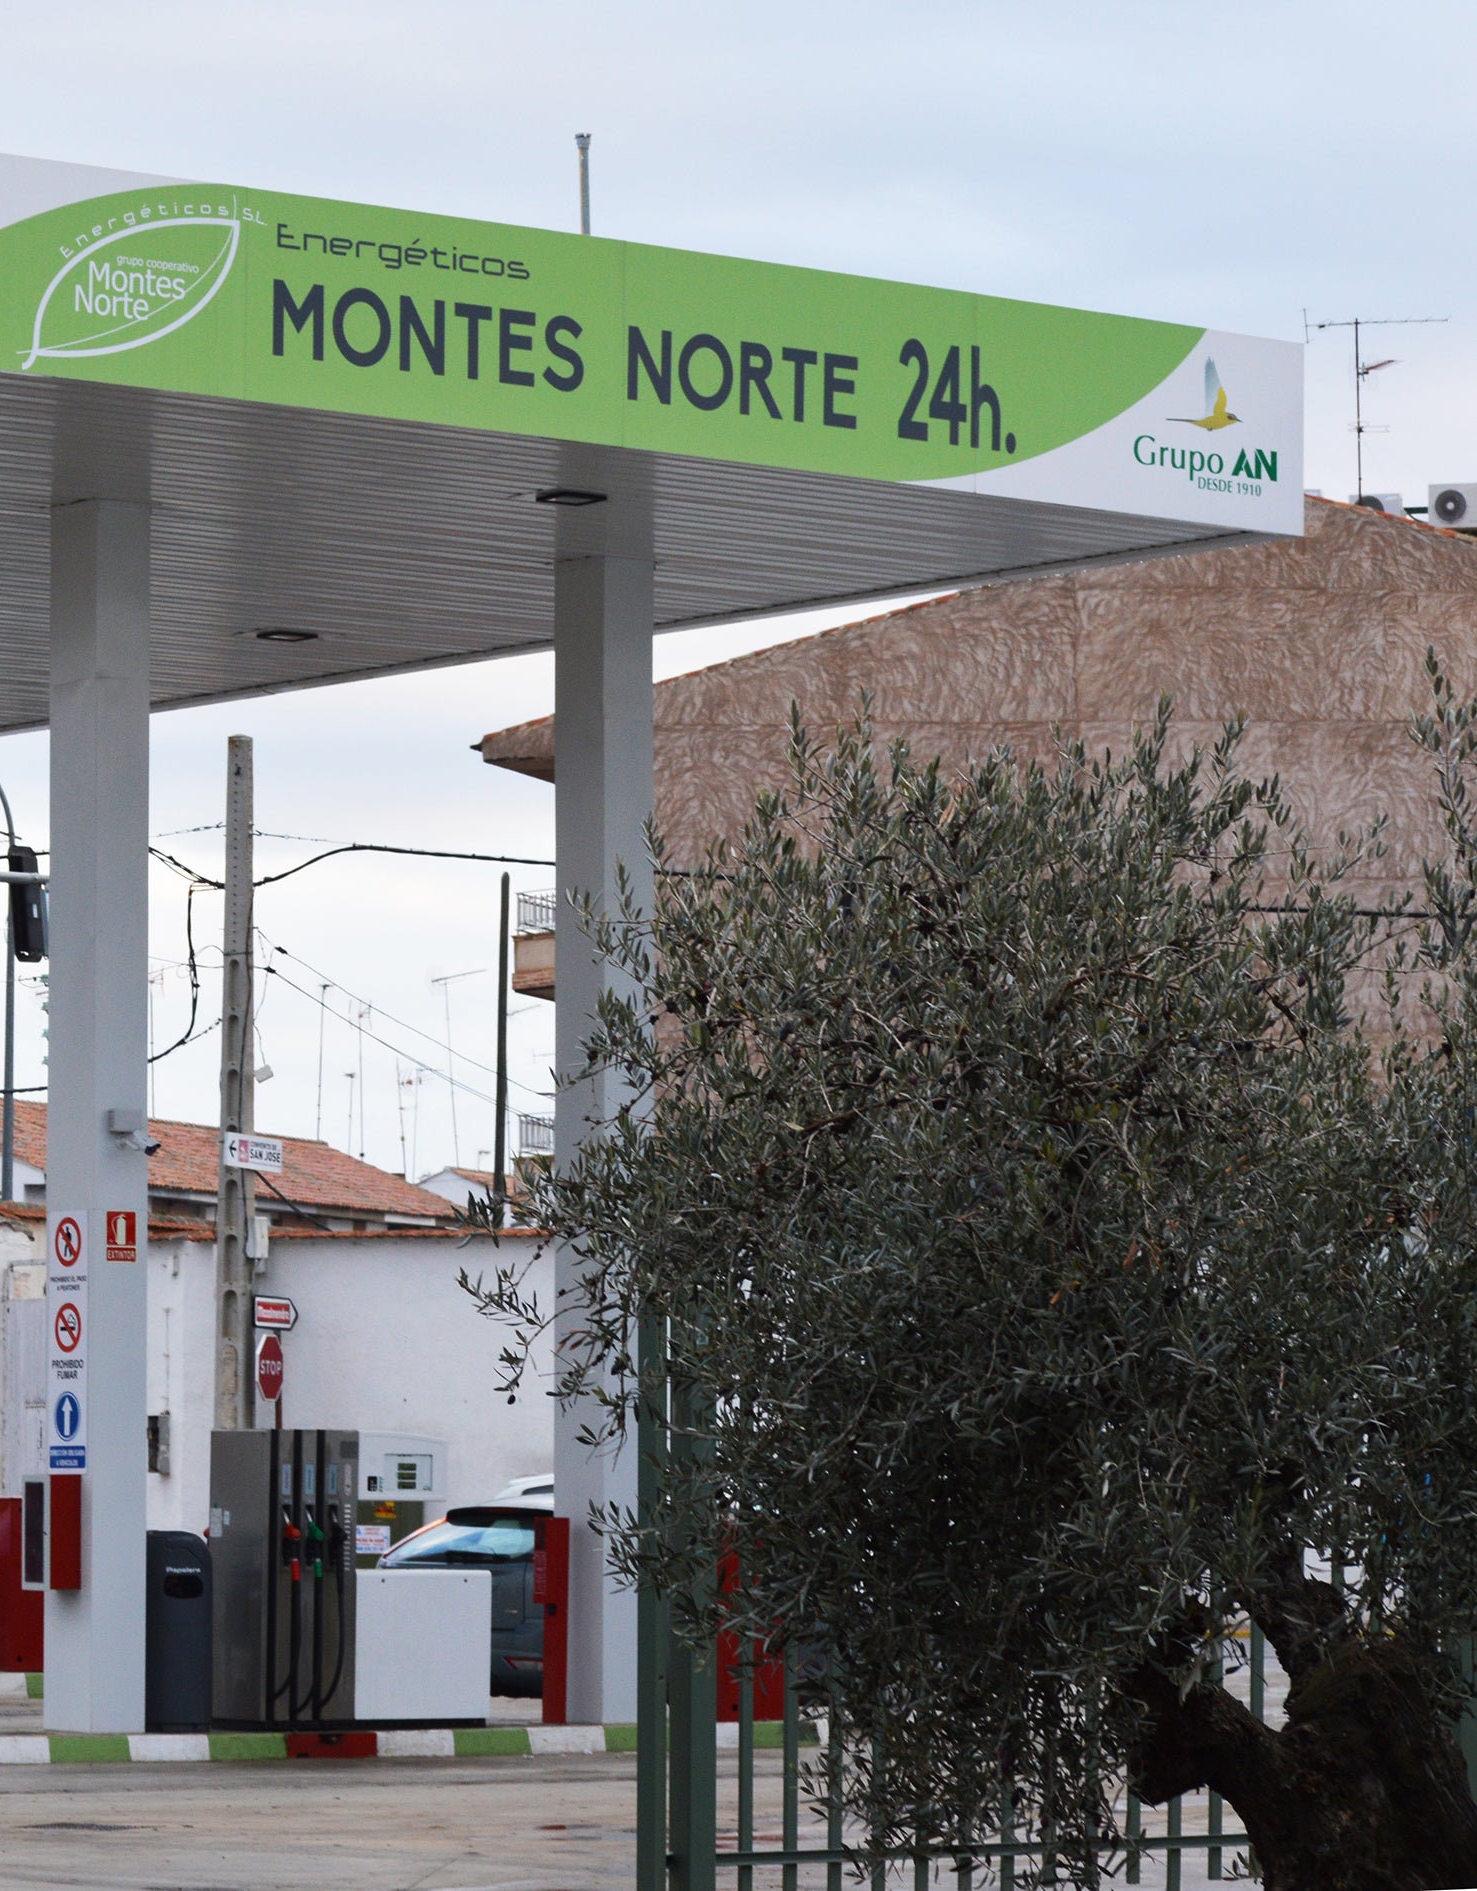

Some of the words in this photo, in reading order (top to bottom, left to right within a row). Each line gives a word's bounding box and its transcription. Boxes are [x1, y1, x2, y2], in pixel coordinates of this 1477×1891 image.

[59, 203, 229, 258] Energéticos
[277, 222, 530, 280] Energéticos
[116, 255, 144, 267] grupo
[146, 259, 200, 274] cooperativo
[89, 260, 186, 300] Montes
[75, 284, 149, 320] Norte
[272, 278, 585, 392] MONTES
[627, 325, 859, 431] NORTE
[898, 337, 1017, 455] 24h.
[1133, 435, 1224, 481] Grupo
[1231, 448, 1278, 482] AN
[1197, 476, 1233, 493] DESDE
[1237, 483, 1262, 497] 1910
[249, 1148, 263, 1160] SAN
[107, 1249, 136, 1260] EXTINTOR
[52, 1359, 84, 1370] PROHIBIDO
[260, 1360, 281, 1375] STOP
[57, 1371, 78, 1380] FUMAR
